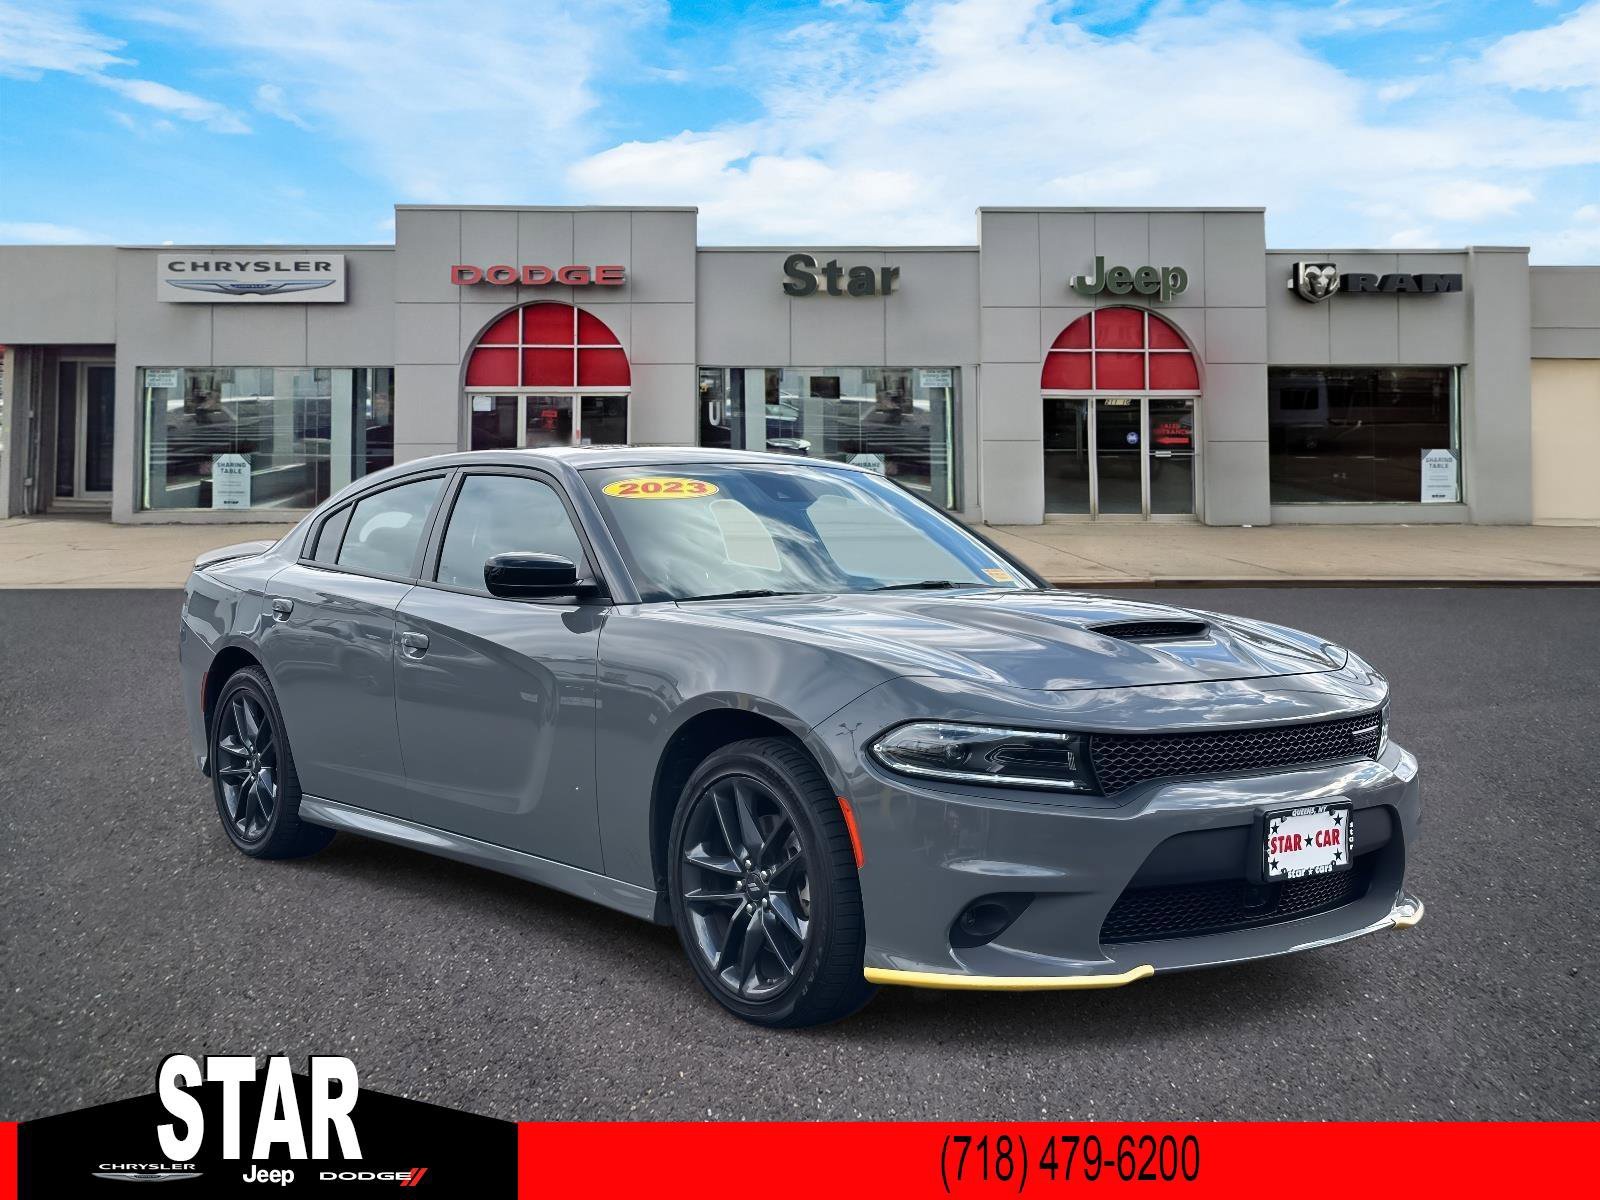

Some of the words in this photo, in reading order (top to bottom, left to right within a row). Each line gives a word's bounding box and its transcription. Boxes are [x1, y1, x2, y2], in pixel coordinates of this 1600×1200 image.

[168, 261, 332, 272] CHRYSLER
[451, 264, 627, 286] DODGE
[782, 253, 901, 297] Star
[1070, 256, 1189, 302] Jeep
[1344, 272, 1463, 294] RAM
[618, 481, 707, 495] 2023
[1270, 833, 1302, 855] STAR
[1315, 828, 1340, 848] CAR
